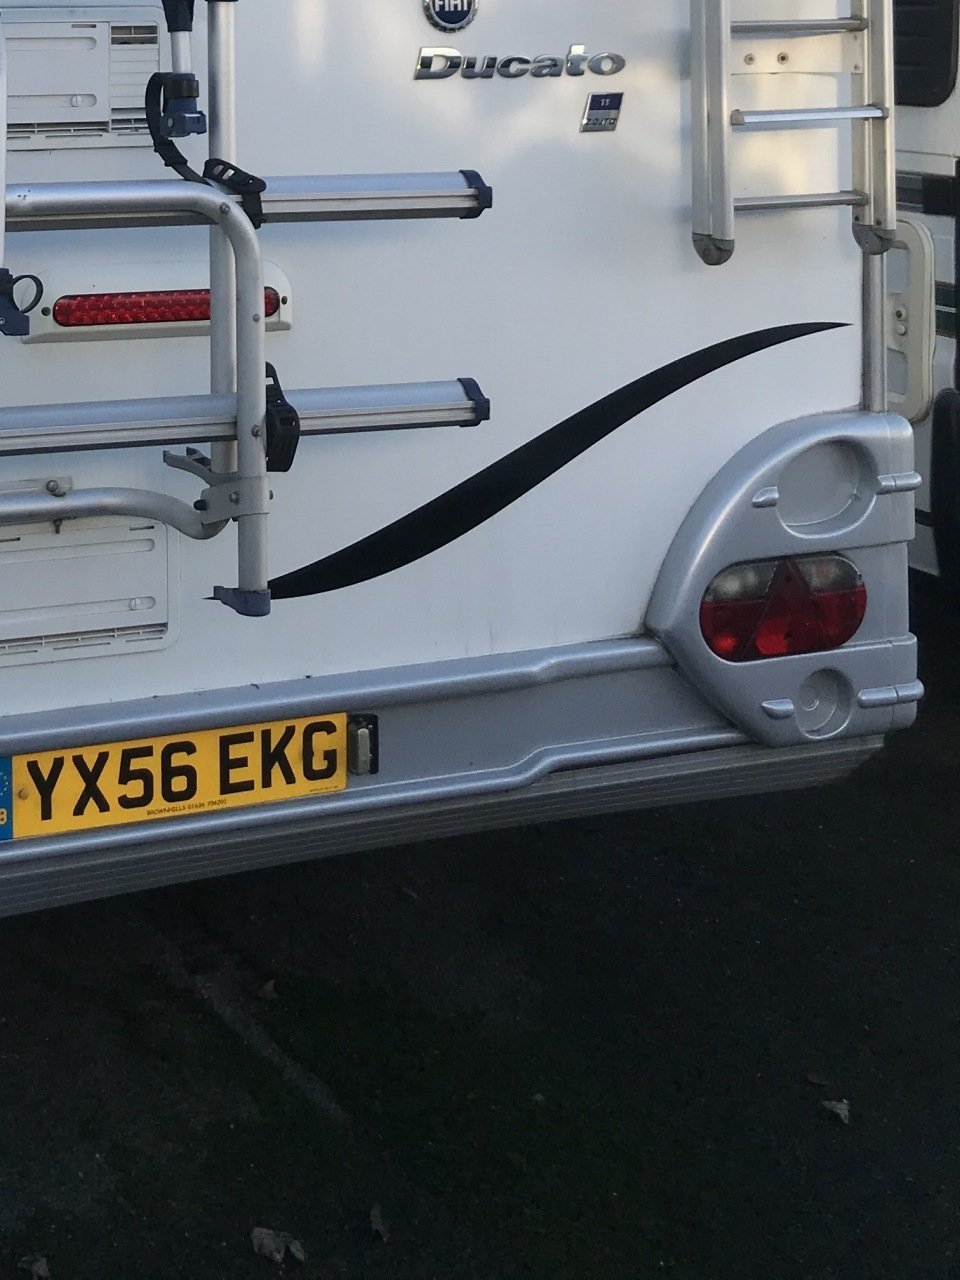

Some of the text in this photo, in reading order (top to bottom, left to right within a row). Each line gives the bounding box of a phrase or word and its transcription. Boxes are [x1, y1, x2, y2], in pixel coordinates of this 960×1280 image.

[413, 44, 626, 80] Ducato
[26, 720, 338, 820] YX56 EKG
